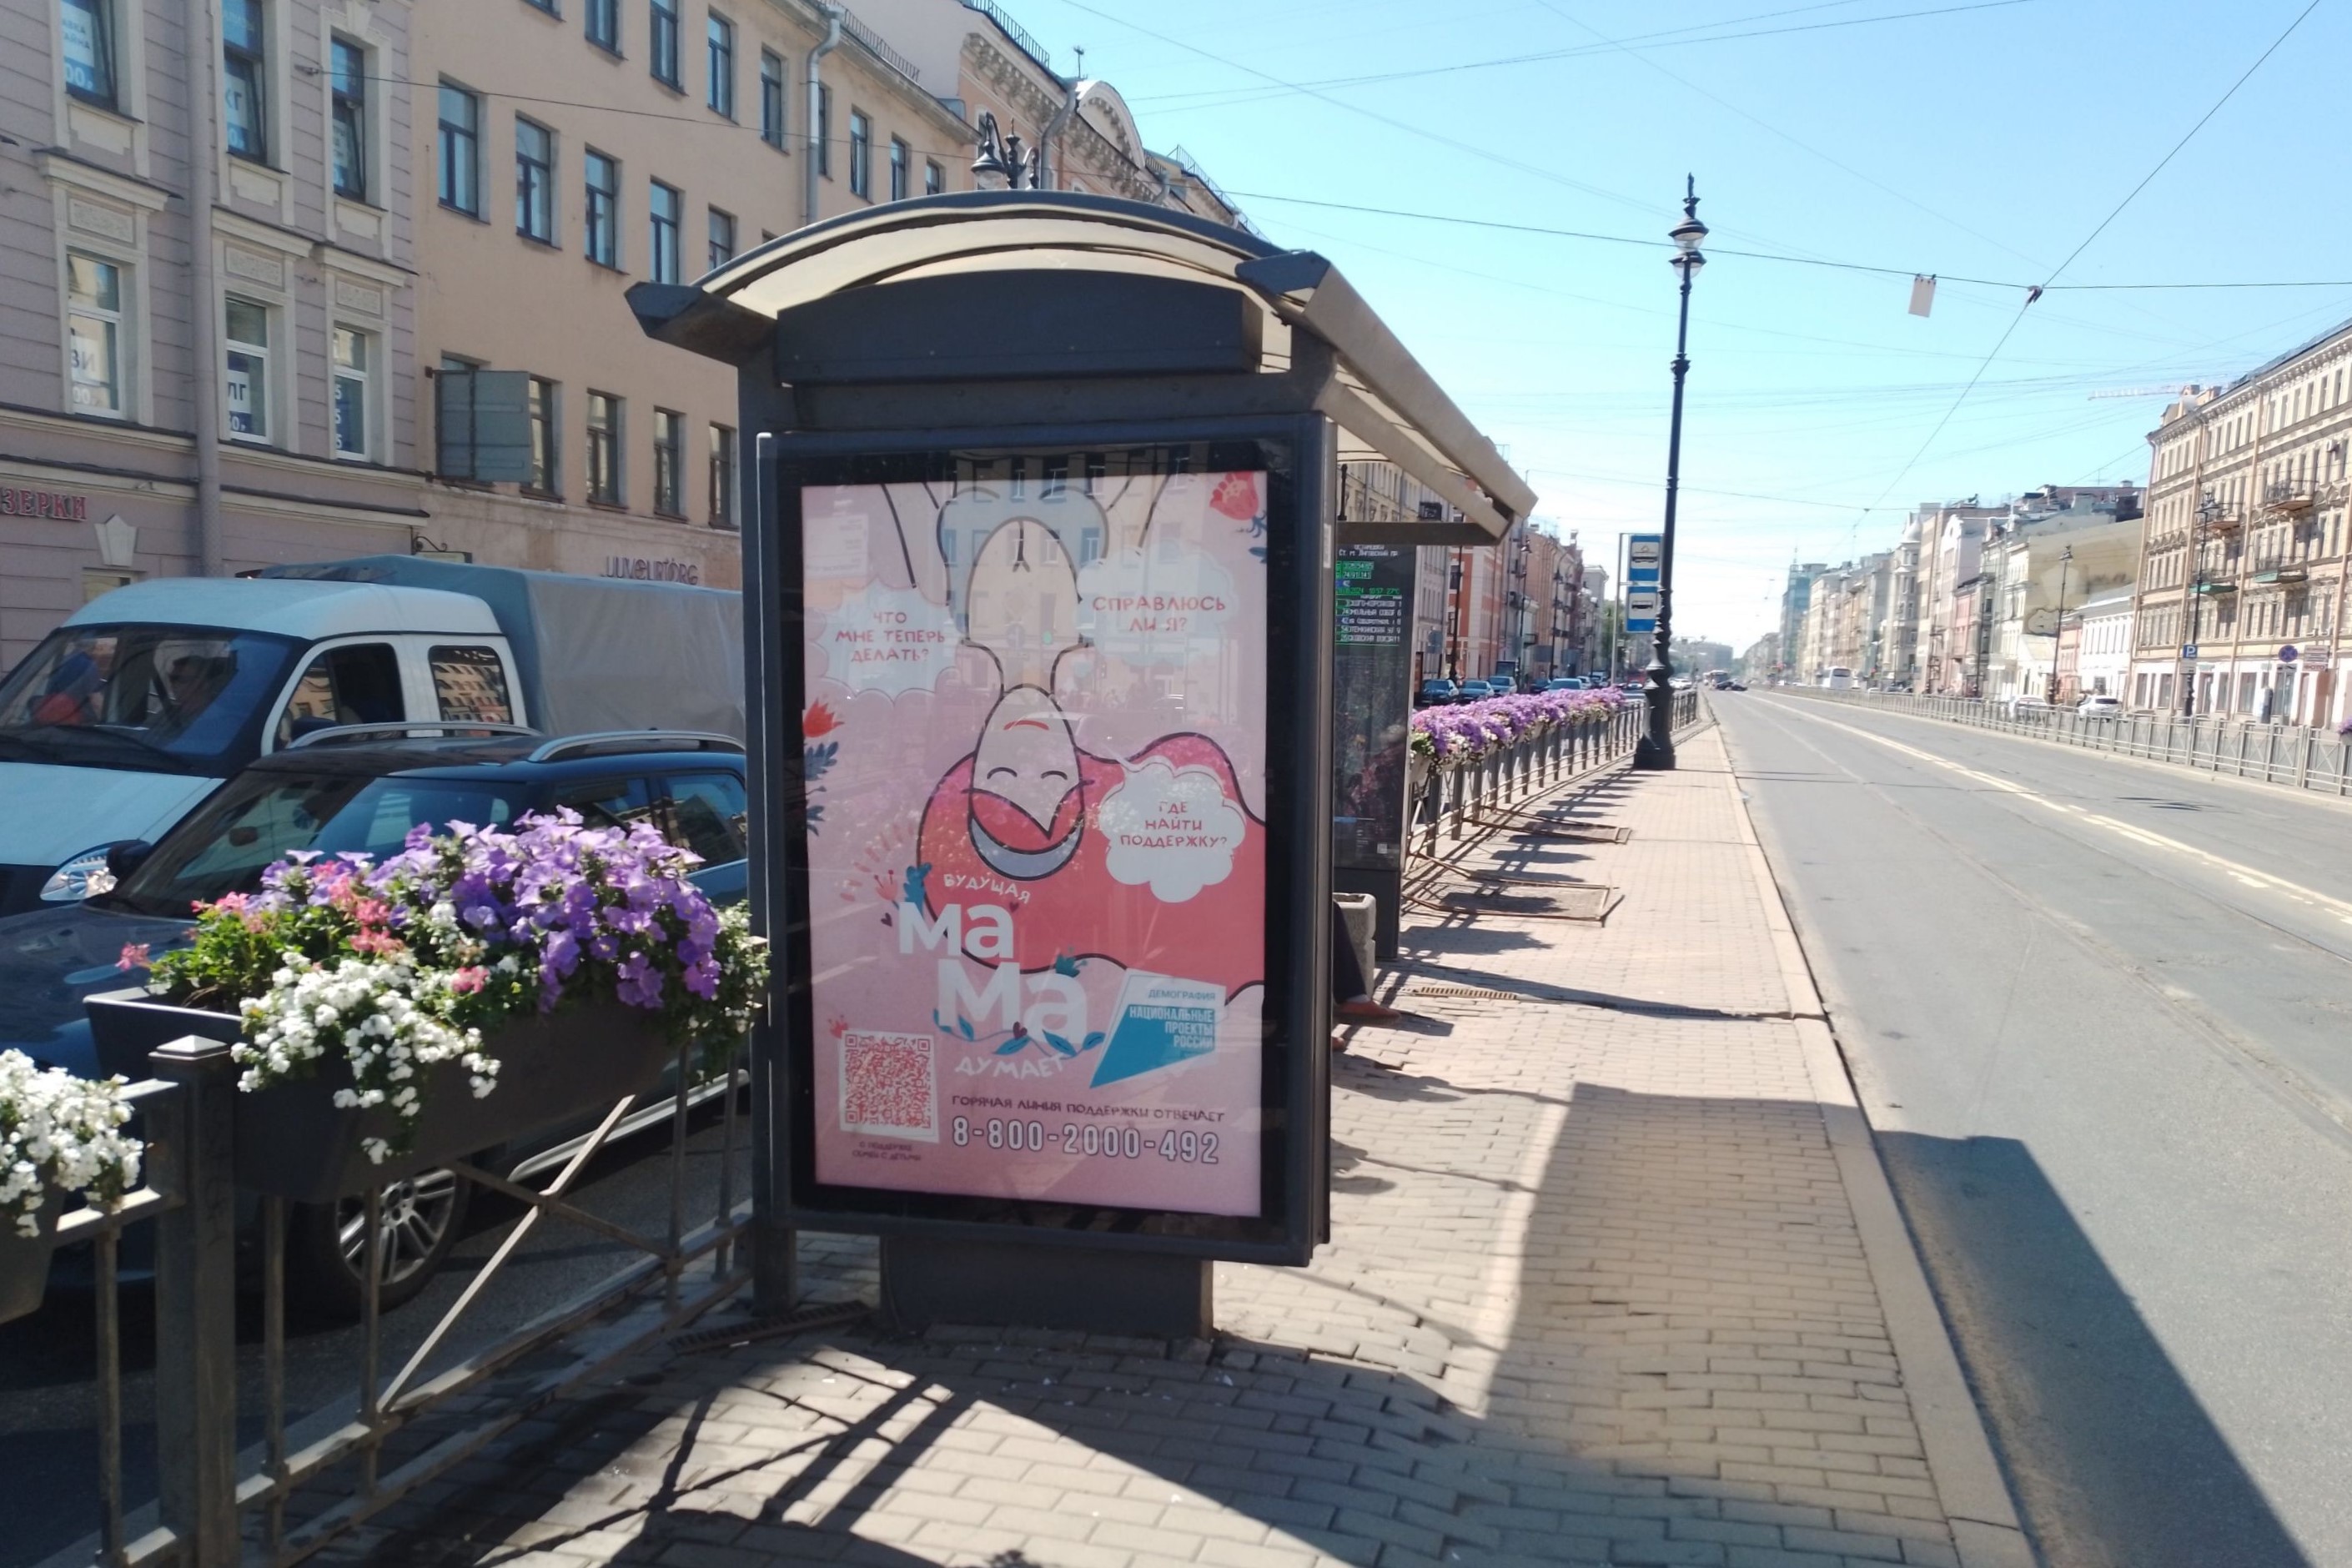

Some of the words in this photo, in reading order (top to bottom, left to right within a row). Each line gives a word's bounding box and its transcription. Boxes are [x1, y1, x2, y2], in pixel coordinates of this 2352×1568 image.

[1093, 596, 1225, 611] СПРАВЛЮСЬ
[873, 611, 907, 624] ЧТО
[1129, 616, 1157, 631] ЛИ
[1165, 616, 1188, 631] Я?
[835, 630, 874, 642] МНЕ
[883, 630, 945, 643] ТЕПЕРЬ
[851, 648, 929, 662] ДЕЛАТЬ?
[1158, 801, 1188, 814] ГДЕ
[1145, 816, 1202, 831] НАЙТИ
[1120, 835, 1228, 848] ПОДДЕРЖКУ?
[943, 873, 1031, 905] БУДУЩАЯ
[1148, 989, 1215, 1001] ДЕМОГРАФИЯ
[1129, 1006, 1214, 1023] НАЦИОНАЛЬНЫЕ
[1165, 1021, 1214, 1035] ПРОЕКТЫ
[1173, 1034, 1214, 1048] РОССИИ
[955, 1053, 1064, 1079] ДУМАЕТ
[952, 1095, 1013, 1109] ГОРЯЧАЯ
[1017, 1099, 1062, 1113] ЛИНИЯ
[1066, 1103, 1148, 1118] ПОДДЕРЖКИ
[1153, 1108, 1225, 1123] ОТВЕЧАЕТ
[952, 1115, 1219, 1165] 8-800-2000-492
